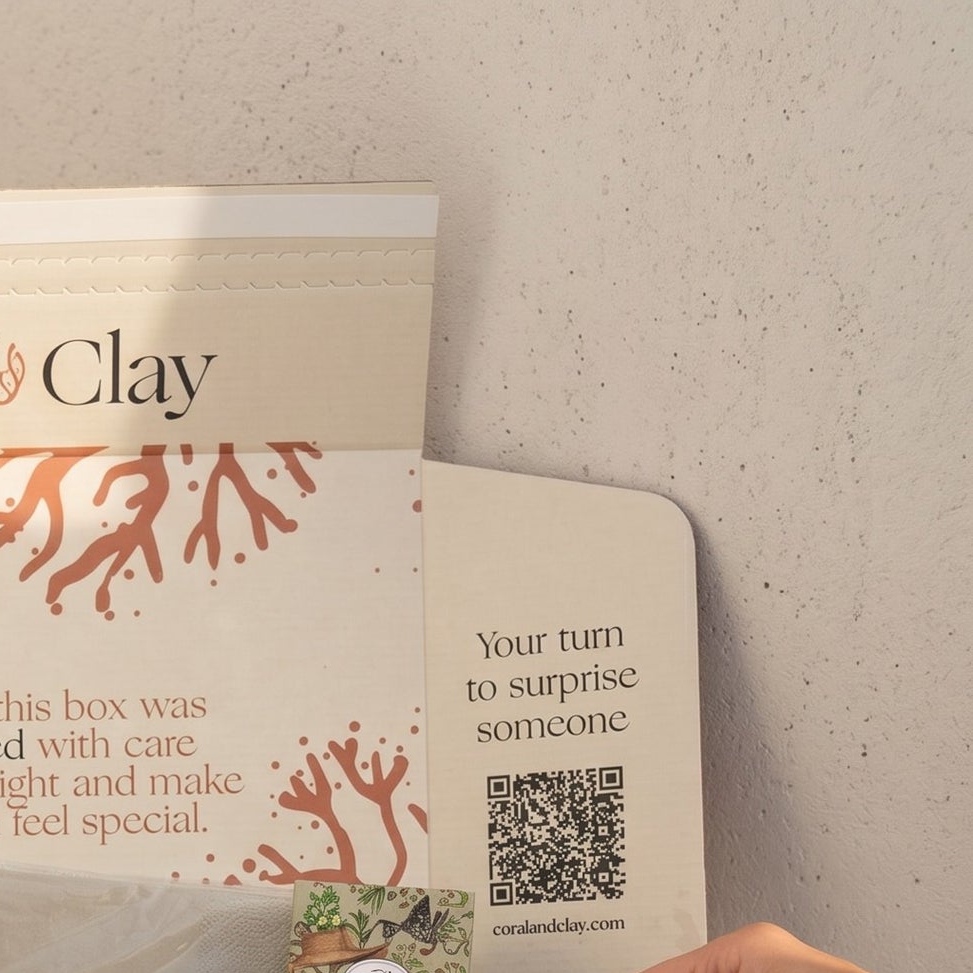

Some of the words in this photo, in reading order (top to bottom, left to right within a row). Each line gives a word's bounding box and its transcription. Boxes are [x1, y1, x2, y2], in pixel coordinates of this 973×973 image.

[42, 327, 219, 420] Clay
[476, 630, 548, 660] Your
[558, 625, 625, 653] turn
[465, 678, 497, 703] to
[509, 663, 640, 704] surprise
[64, 688, 128, 721] box
[139, 695, 207, 719] was
[477, 709, 631, 743] someone
[37, 727, 111, 760] with
[124, 734, 198, 758] care
[73, 765, 137, 797] and
[149, 763, 246, 796] make
[12, 804, 70, 837] feel
[82, 801, 209, 846] special.
[492, 917, 626, 937] coralandclay.com
